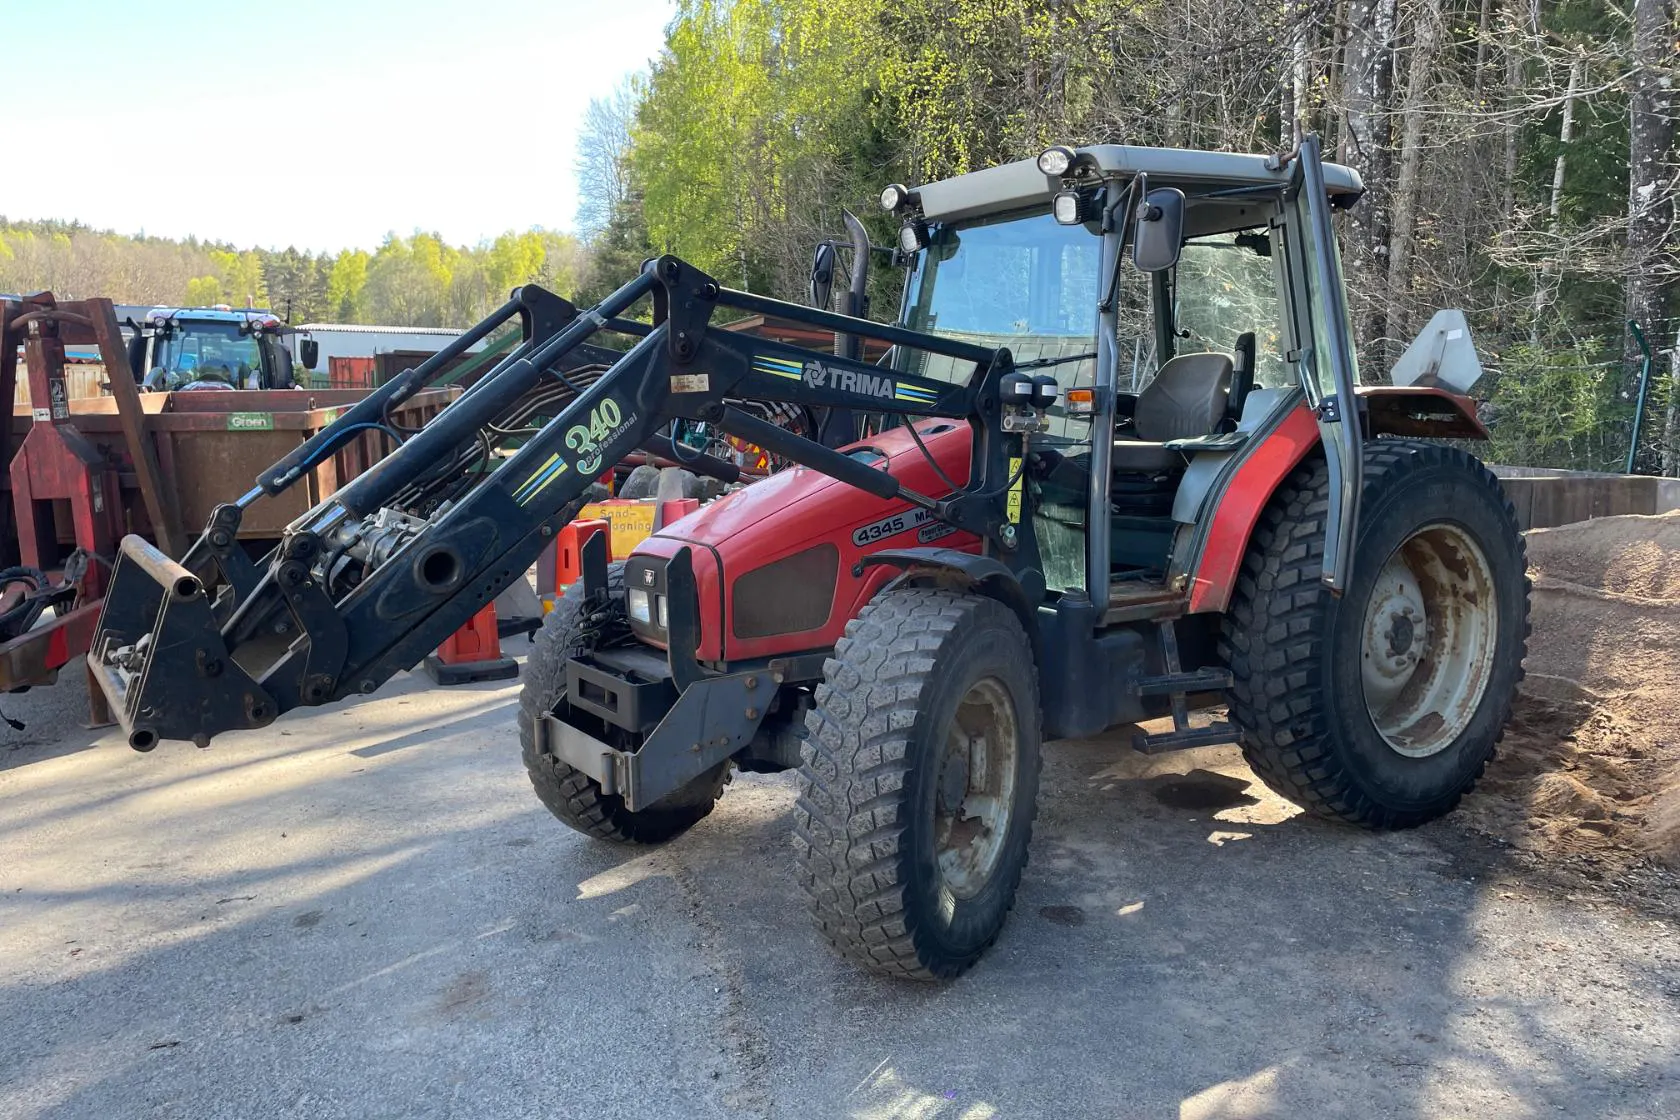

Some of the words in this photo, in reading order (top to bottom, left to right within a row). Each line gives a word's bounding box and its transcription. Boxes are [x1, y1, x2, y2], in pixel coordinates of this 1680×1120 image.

[827, 367, 894, 399] TRIMA
[565, 398, 621, 474] 340
[586, 412, 638, 465] professional
[612, 521, 652, 533] agning
[858, 518, 904, 541] 4345
